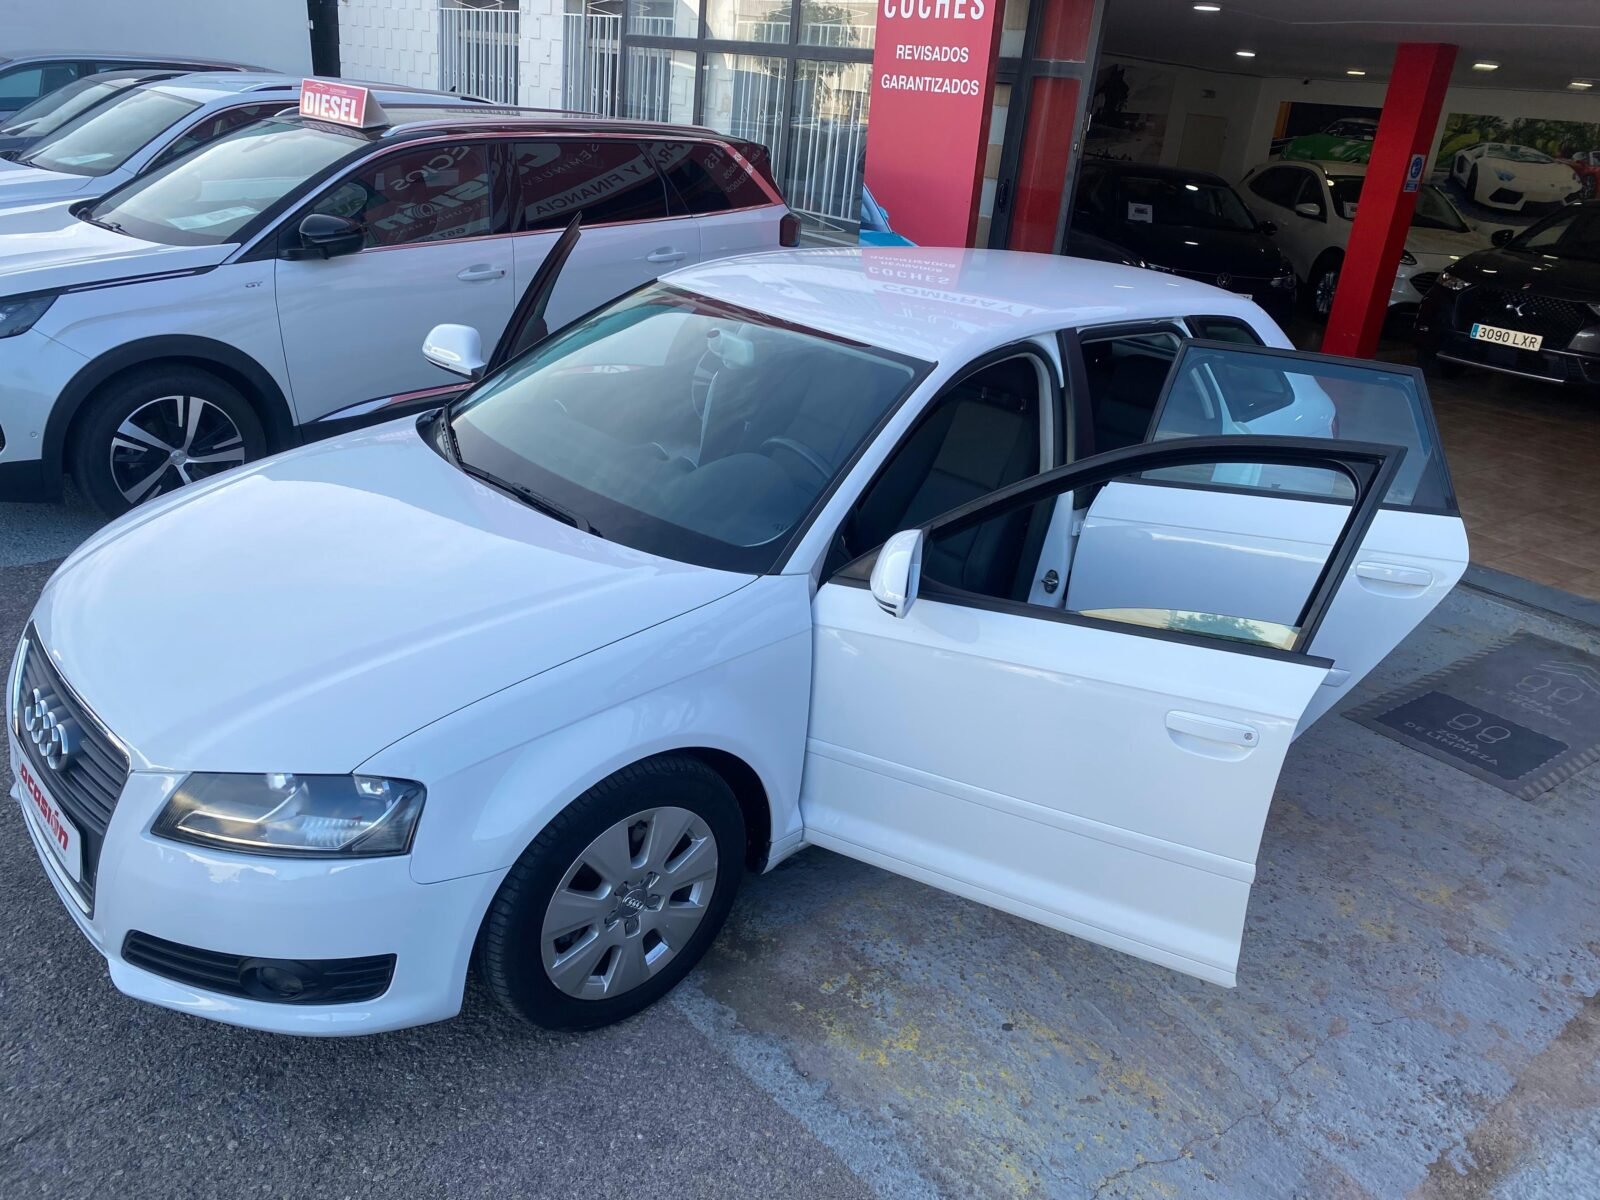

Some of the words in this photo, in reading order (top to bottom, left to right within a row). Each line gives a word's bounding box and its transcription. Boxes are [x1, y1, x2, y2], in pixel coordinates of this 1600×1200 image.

[884, 0, 985, 20] COCHES
[896, 44, 969, 63] REVISADOS
[881, 74, 979, 96] GARANTIZADOS
[303, 91, 358, 123] DIESEL
[1479, 327, 1510, 343] 3090
[1512, 333, 1538, 349] LXR
[1434, 728, 1480, 749] ZONA
[20, 761, 69, 852] ocasión
